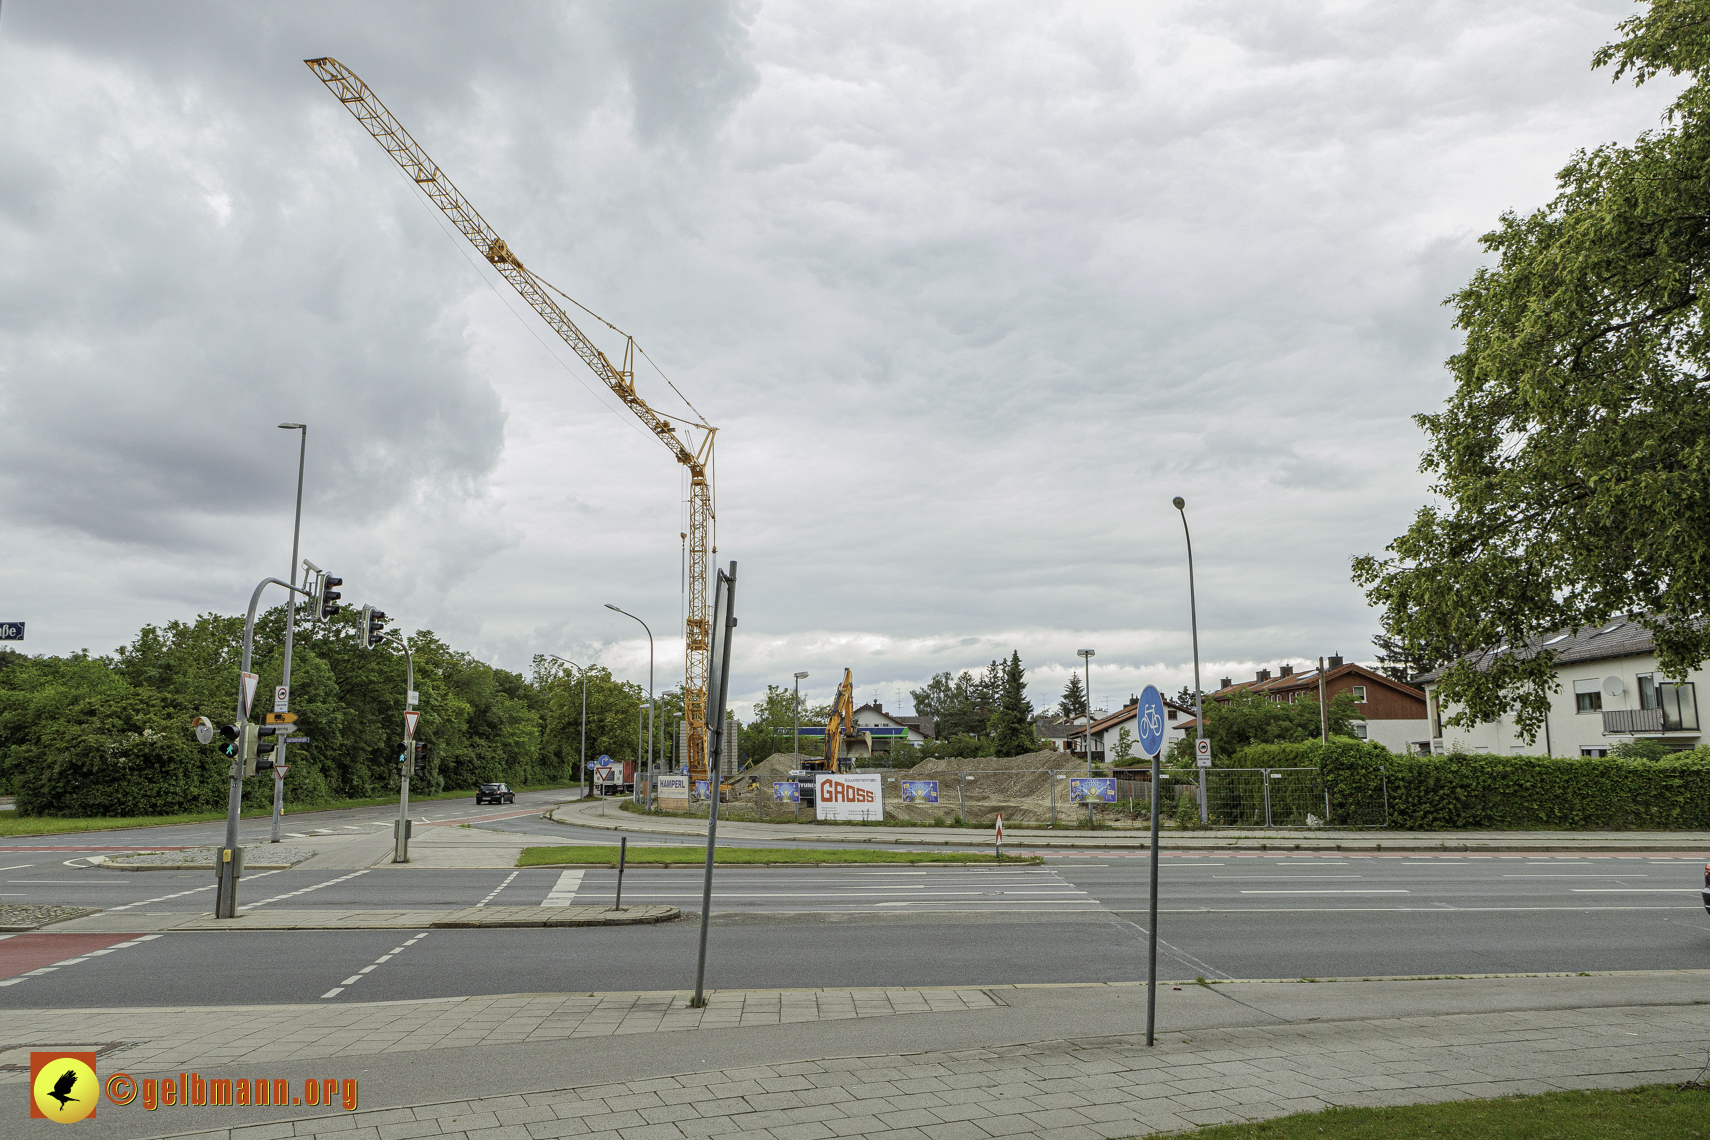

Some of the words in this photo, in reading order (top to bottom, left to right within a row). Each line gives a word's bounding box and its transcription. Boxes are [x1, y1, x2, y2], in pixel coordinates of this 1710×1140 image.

[0, 624, 17, 639] ße
[659, 779, 686, 789] HAMPERL
[820, 778, 874, 803] GROSS
